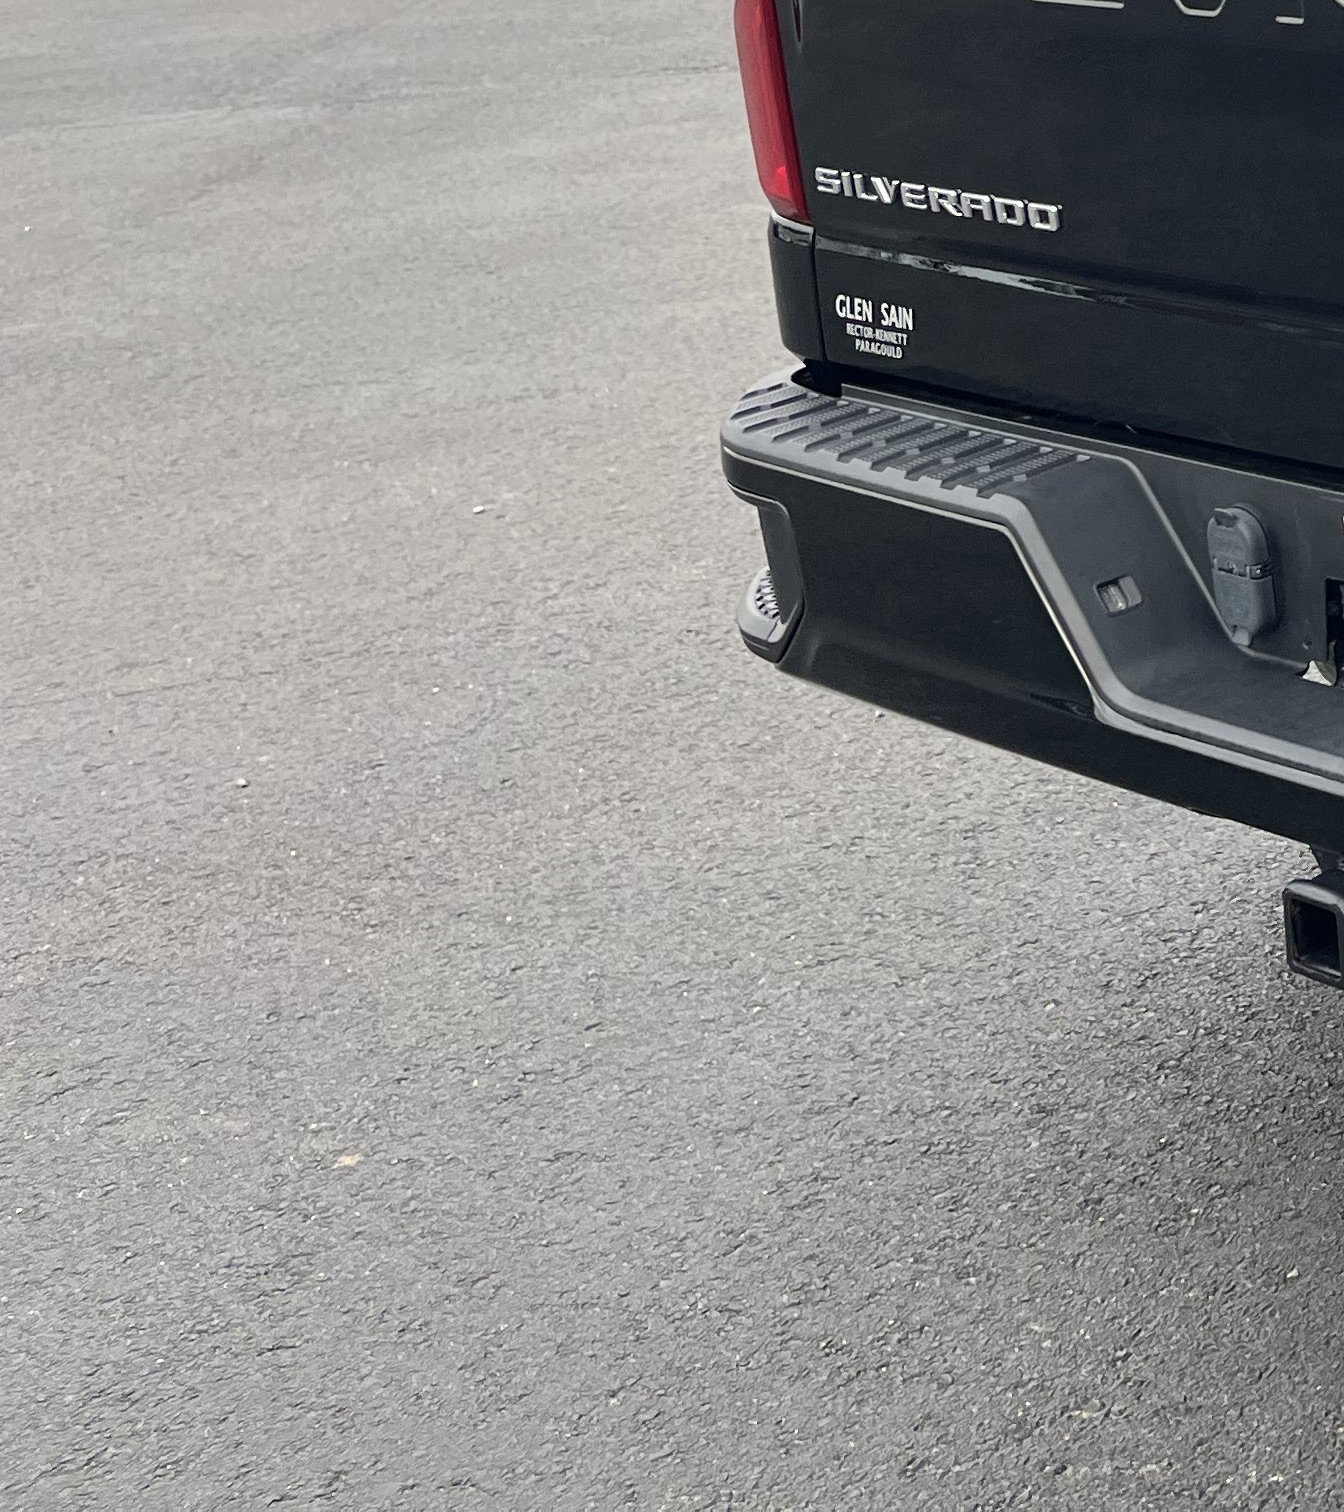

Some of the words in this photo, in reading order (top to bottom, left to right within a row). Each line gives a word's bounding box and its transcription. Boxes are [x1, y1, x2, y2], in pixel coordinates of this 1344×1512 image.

[815, 166, 1062, 232] SILVERADO
[835, 294, 873, 323] GLEN
[880, 302, 914, 331] SAIN
[855, 338, 903, 359] PARAGOULD
